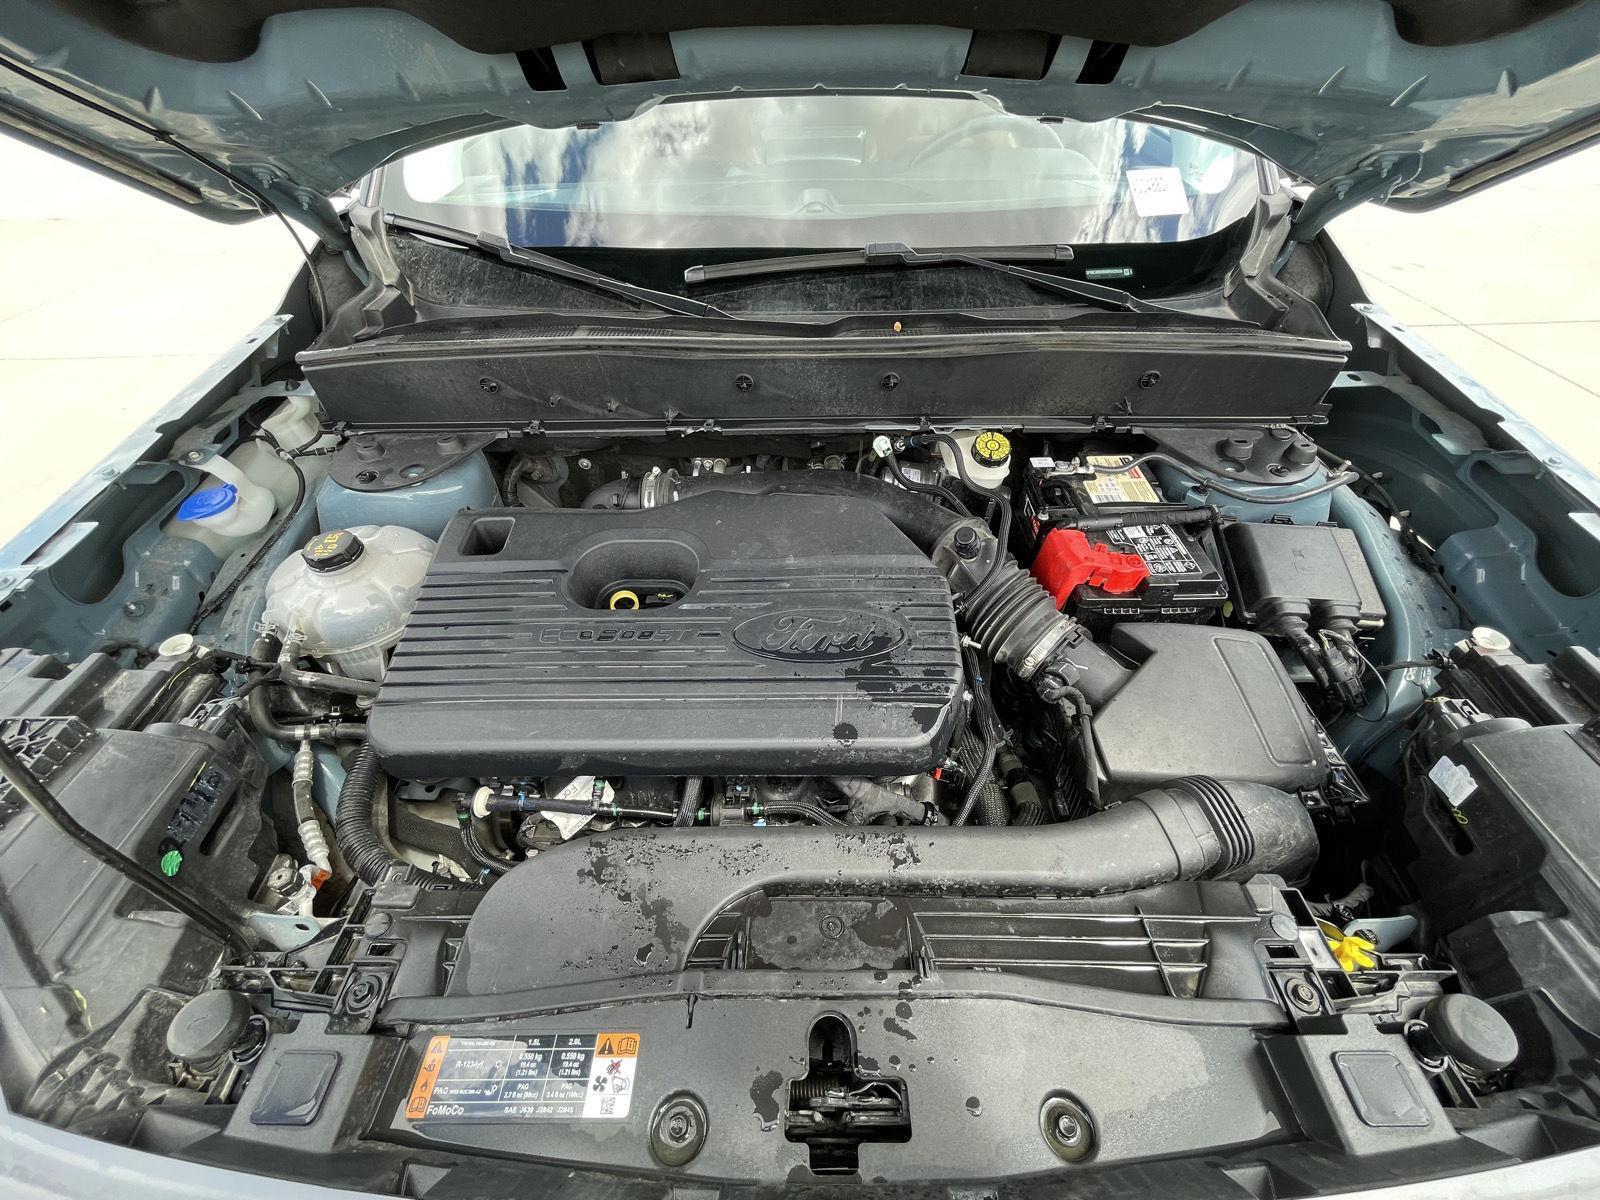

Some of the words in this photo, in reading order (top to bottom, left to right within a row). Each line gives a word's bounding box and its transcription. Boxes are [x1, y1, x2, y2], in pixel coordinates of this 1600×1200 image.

[759, 615, 877, 653] Ford
[568, 1038, 582, 1046] 2.0L
[534, 1052, 543, 1062] kg
[576, 1052, 585, 1062] kg
[455, 1060, 485, 1070] R-1234yf
[433, 1087, 449, 1095] PAG
[426, 1104, 465, 1116] FoMoCo
[503, 1106, 518, 1114] SAE
